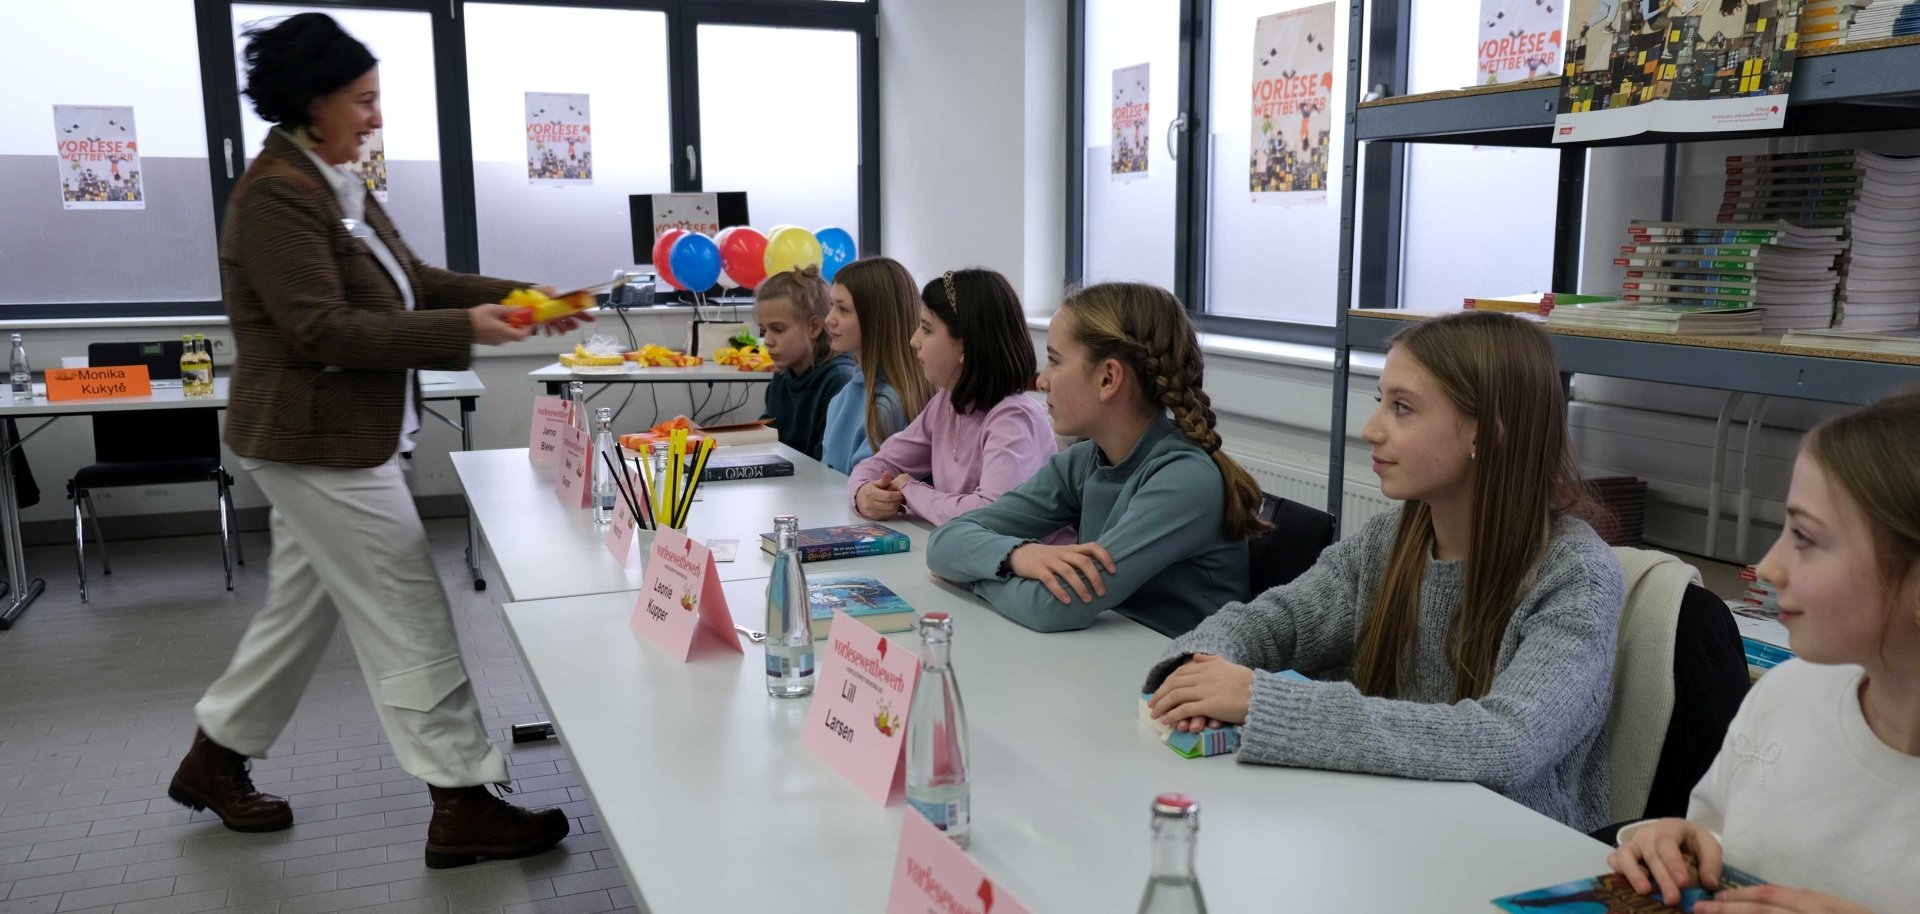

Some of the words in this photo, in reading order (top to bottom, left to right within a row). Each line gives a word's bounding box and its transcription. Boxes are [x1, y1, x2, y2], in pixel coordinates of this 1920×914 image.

[1478, 32, 1546, 59] VORLESE
[1252, 74, 1317, 102] VORLESE
[527, 123, 579, 135] VORLESE
[58, 140, 122, 153] VORLESE
[78, 370, 125, 381] Monika
[725, 466, 764, 480] MOMO
[653, 577, 673, 600] Leonie
[834, 639, 905, 693] vorlesewettbewerb
[841, 680, 857, 703] Lill
[825, 708, 854, 743] Larsen
